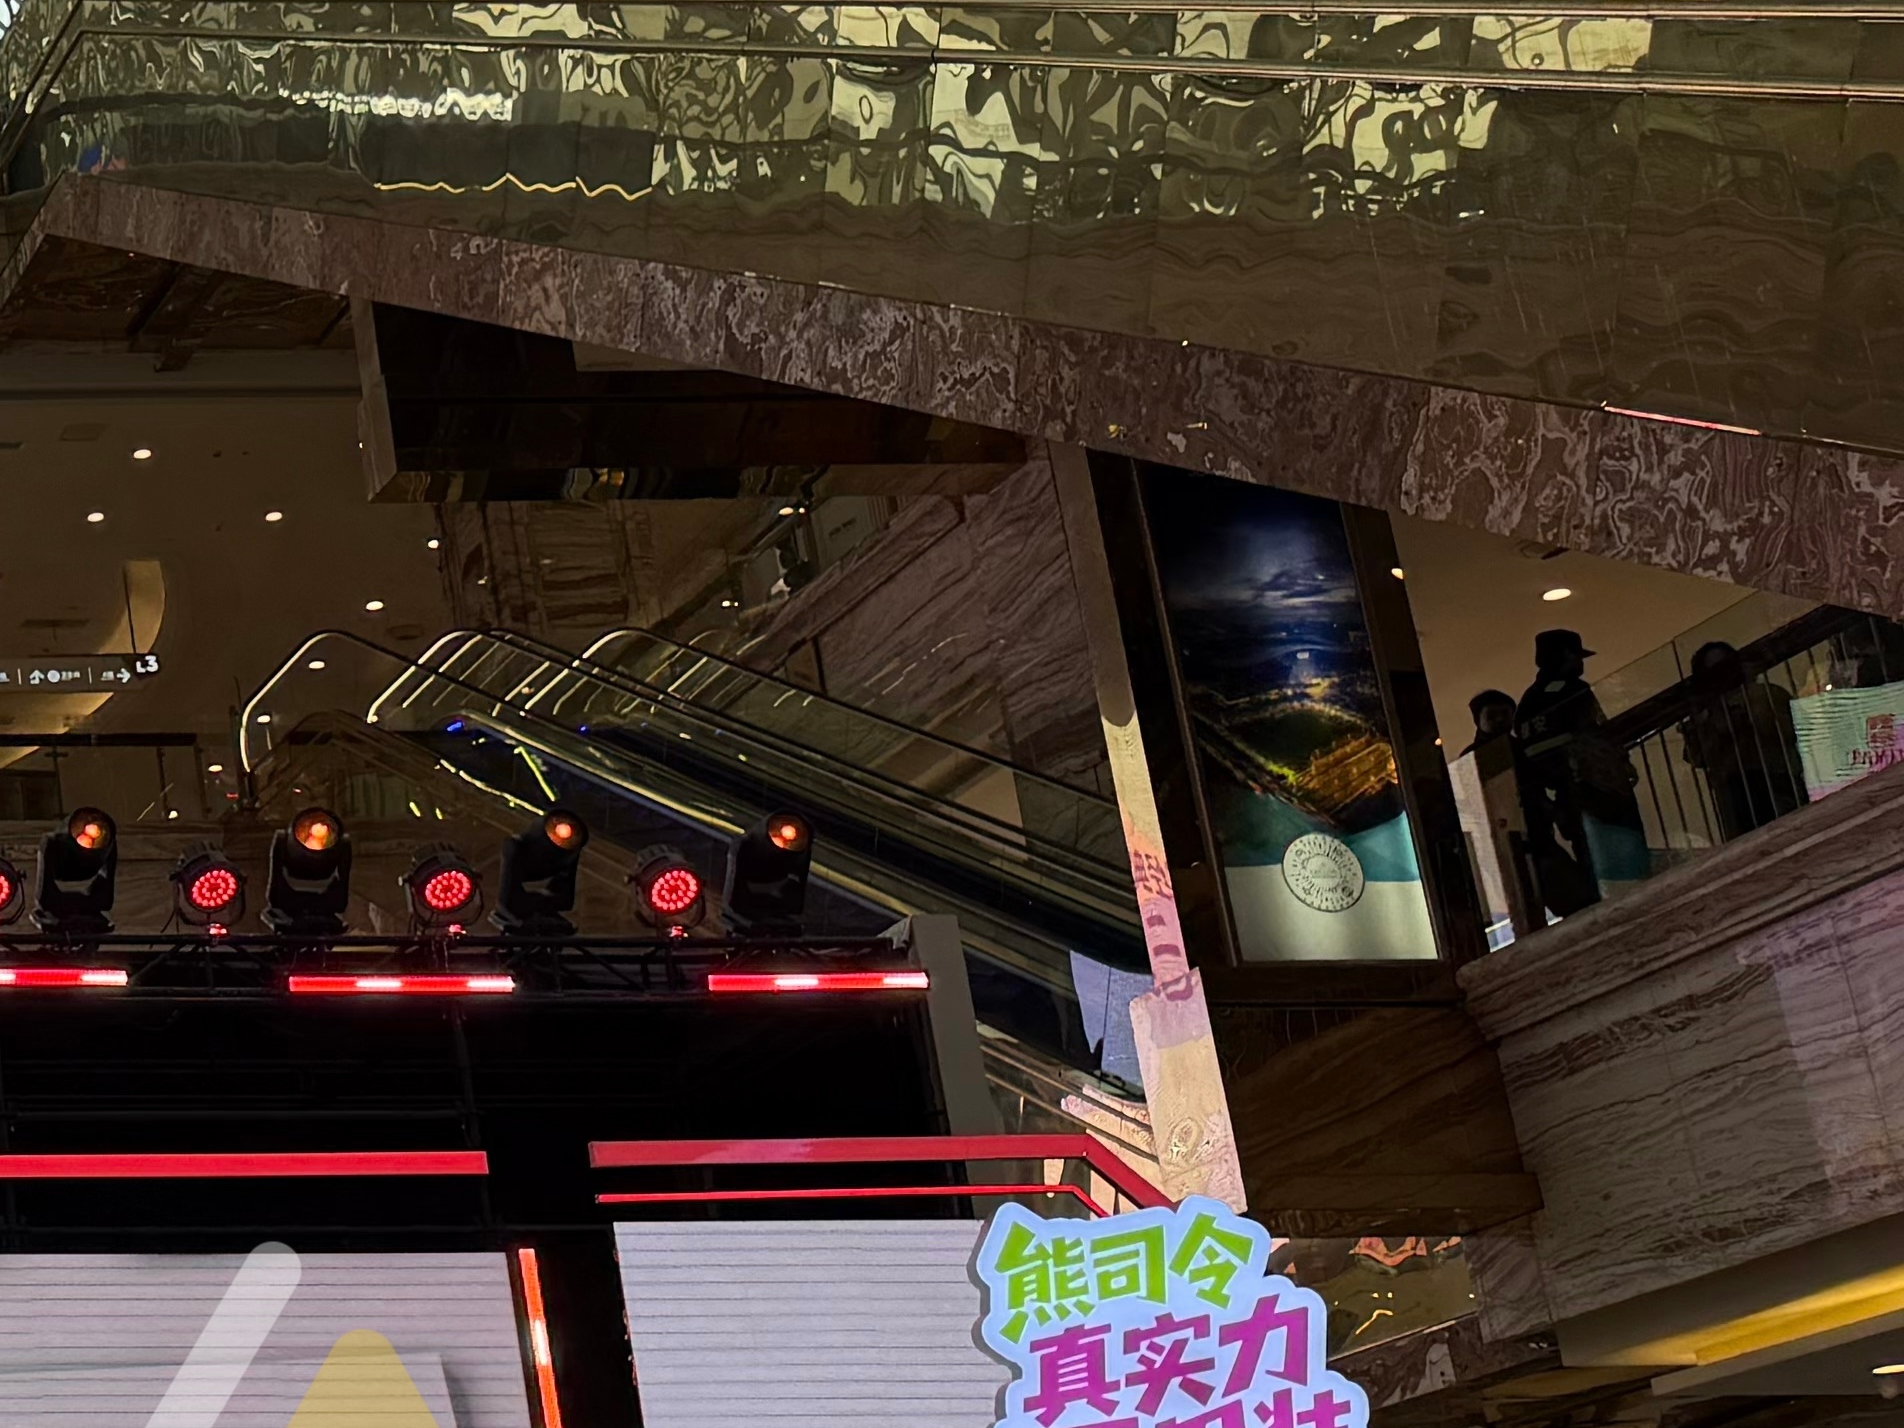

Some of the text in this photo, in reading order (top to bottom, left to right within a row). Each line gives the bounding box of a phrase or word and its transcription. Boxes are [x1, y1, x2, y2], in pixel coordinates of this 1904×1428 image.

[136, 655, 159, 674] L3
[994, 1212, 1254, 1345] 熊司令
[1023, 1293, 1310, 1428] 真实力
